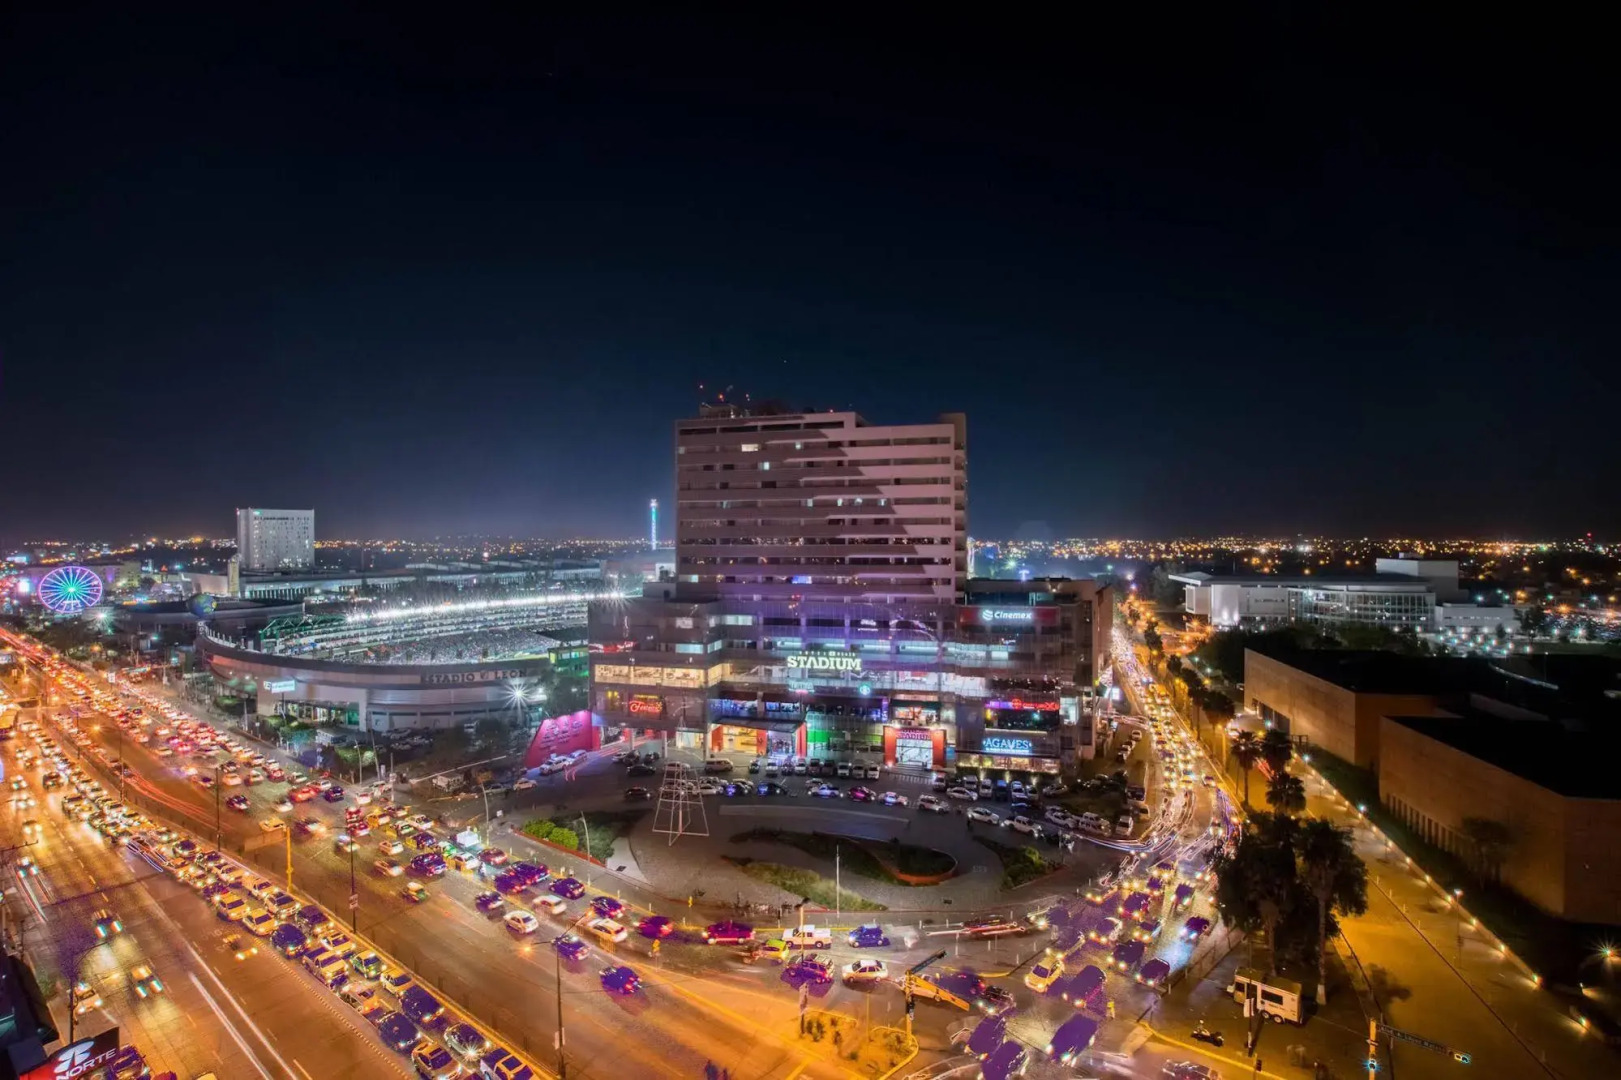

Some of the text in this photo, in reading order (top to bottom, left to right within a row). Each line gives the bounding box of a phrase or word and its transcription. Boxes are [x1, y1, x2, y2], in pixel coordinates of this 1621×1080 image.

[994, 611, 1033, 619] Cinemex
[787, 655, 862, 670] STADIUM
[985, 738, 1029, 750] AGAVES
